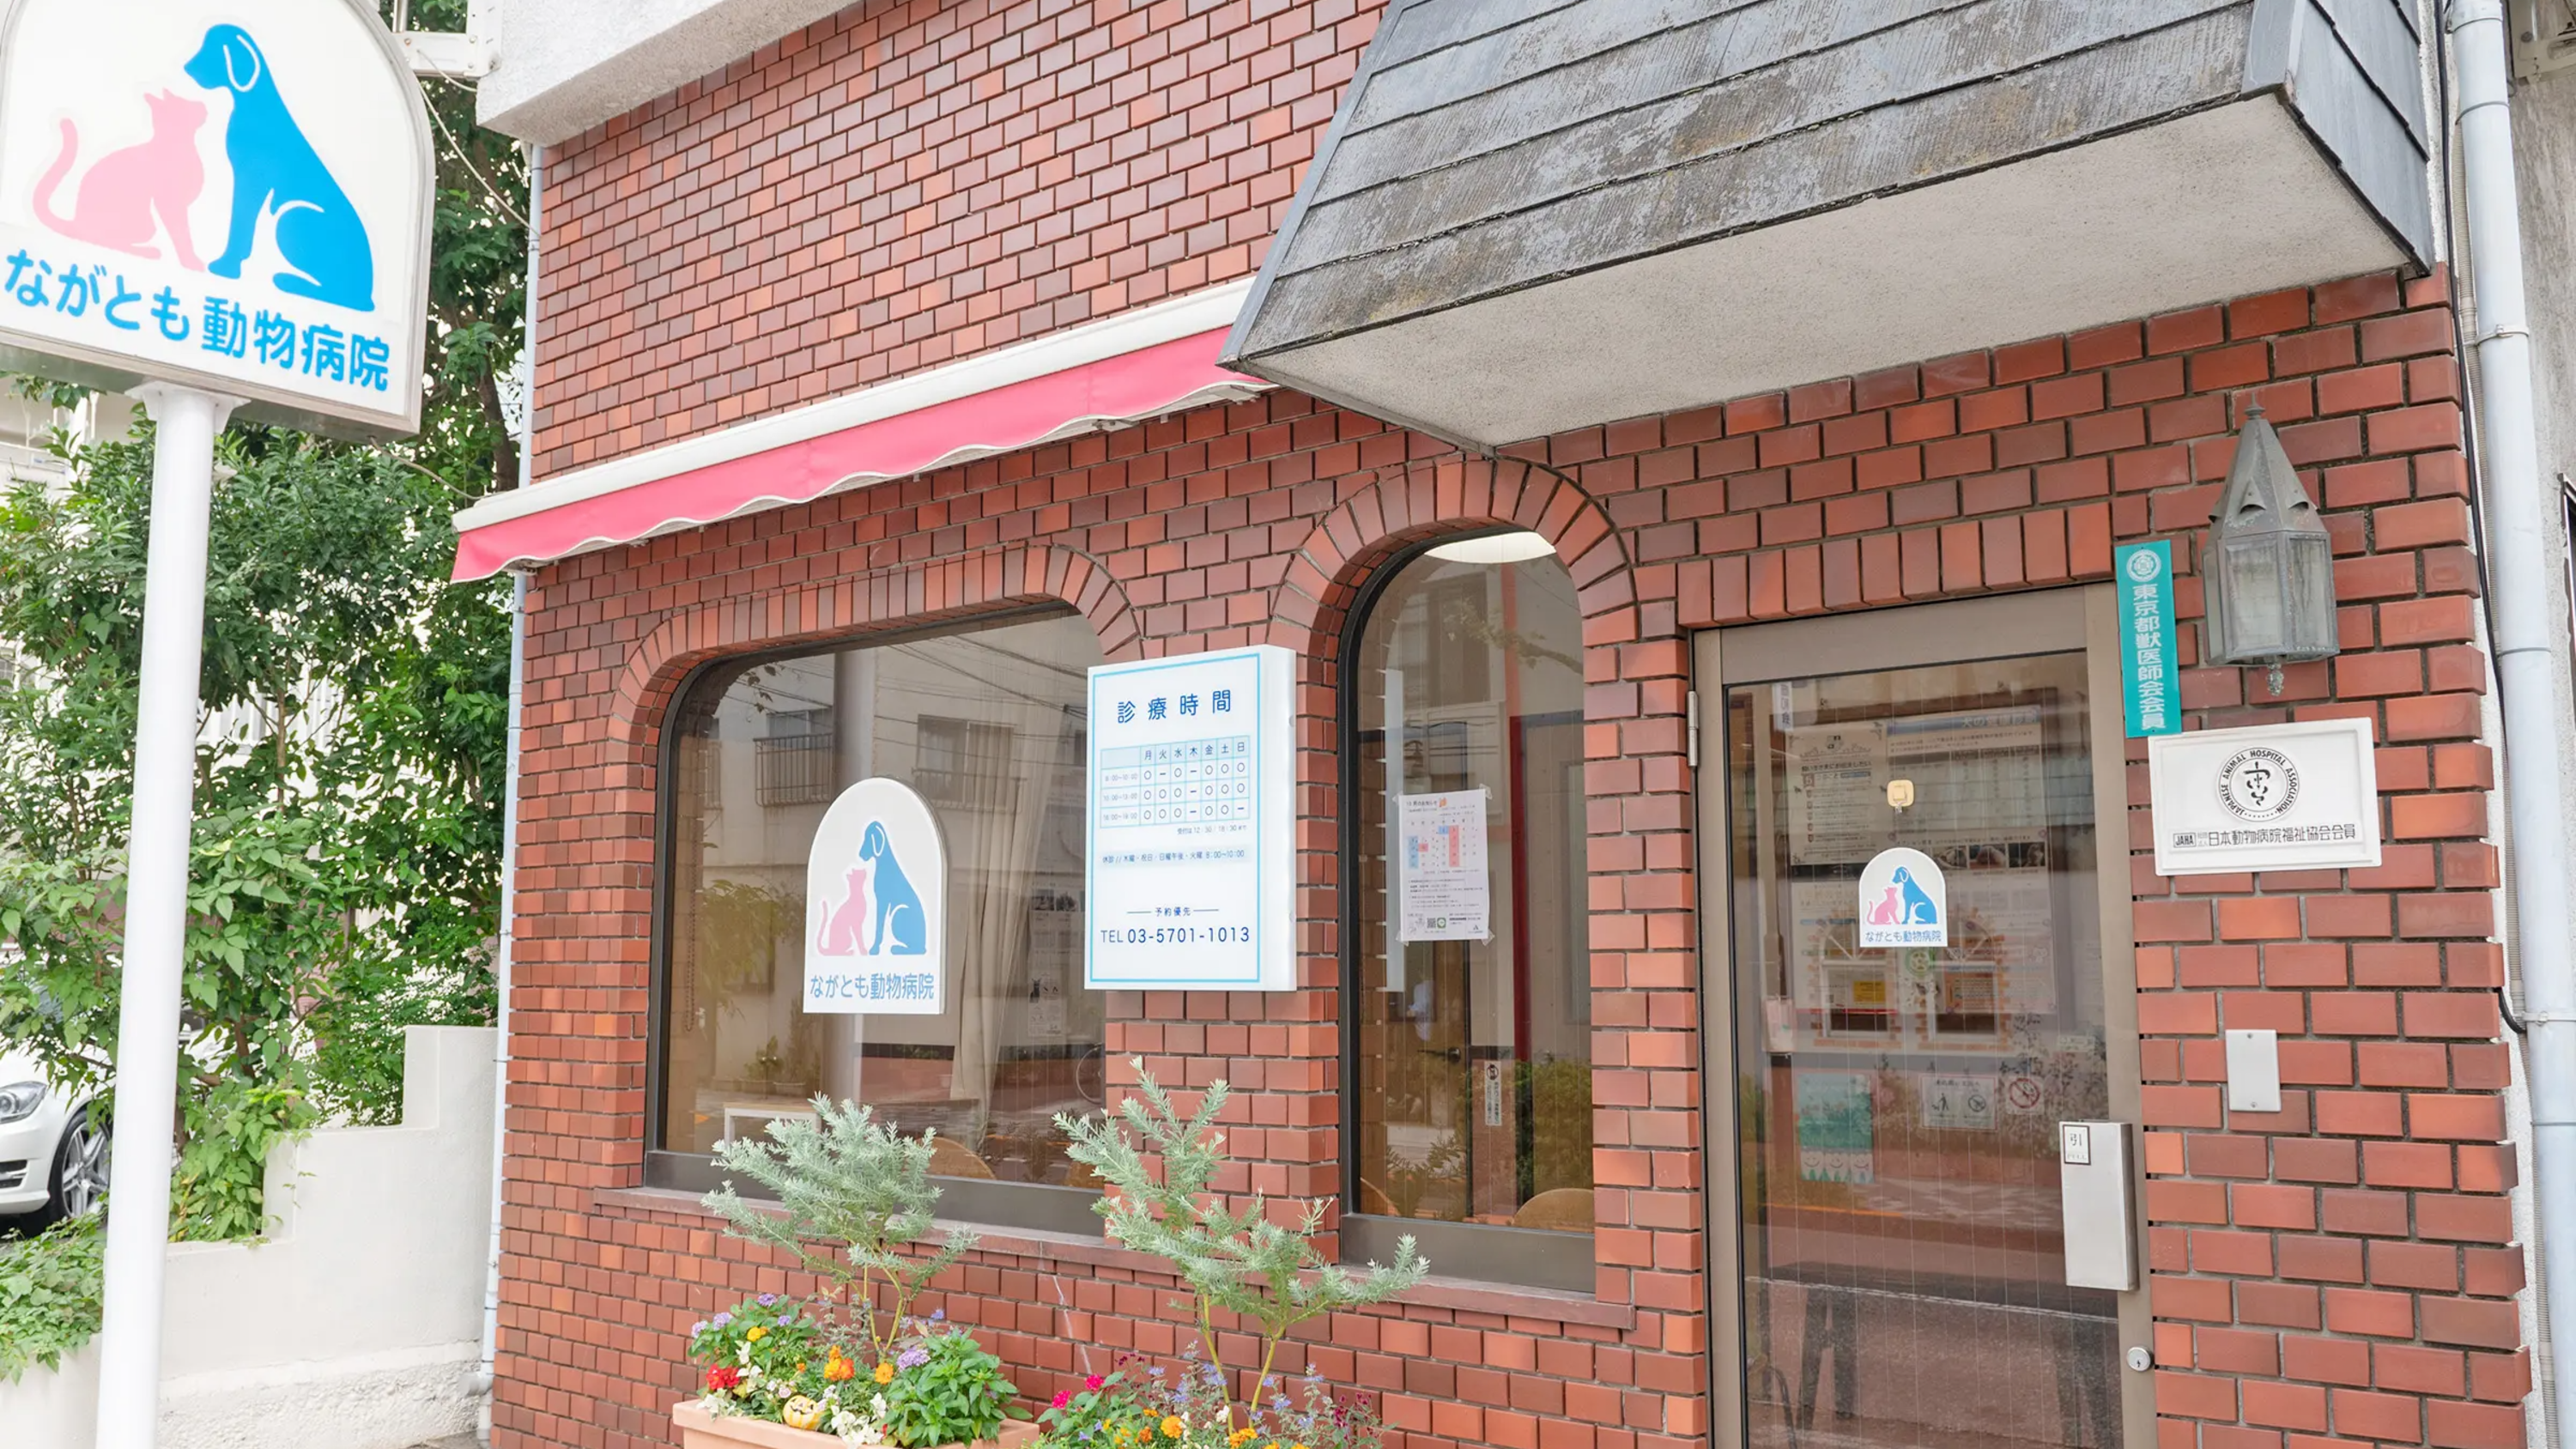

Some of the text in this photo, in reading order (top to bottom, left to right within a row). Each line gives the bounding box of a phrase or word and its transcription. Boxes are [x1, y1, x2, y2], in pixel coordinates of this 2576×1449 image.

[3, 249, 390, 392] ながとも動物病院
[2132, 584, 2167, 730] 東京都獣医師会会員
[1117, 689, 1232, 724] 診療時間
[1144, 742, 1245, 761] 月 火 水 木 金 土 日
[2221, 749, 2298, 815] JAPANESE ANIMAL HOSPITAL ASSOCIATION
[2175, 834, 2194, 846] JAHA
[1155, 906, 1191, 918] 予約優先
[1100, 926, 1250, 943] TEL 03-5701-1013
[1865, 930, 1942, 943] ながとも動物病院
[809, 973, 934, 1000] ながとも動物病院
[2070, 1133, 2082, 1146] 引
